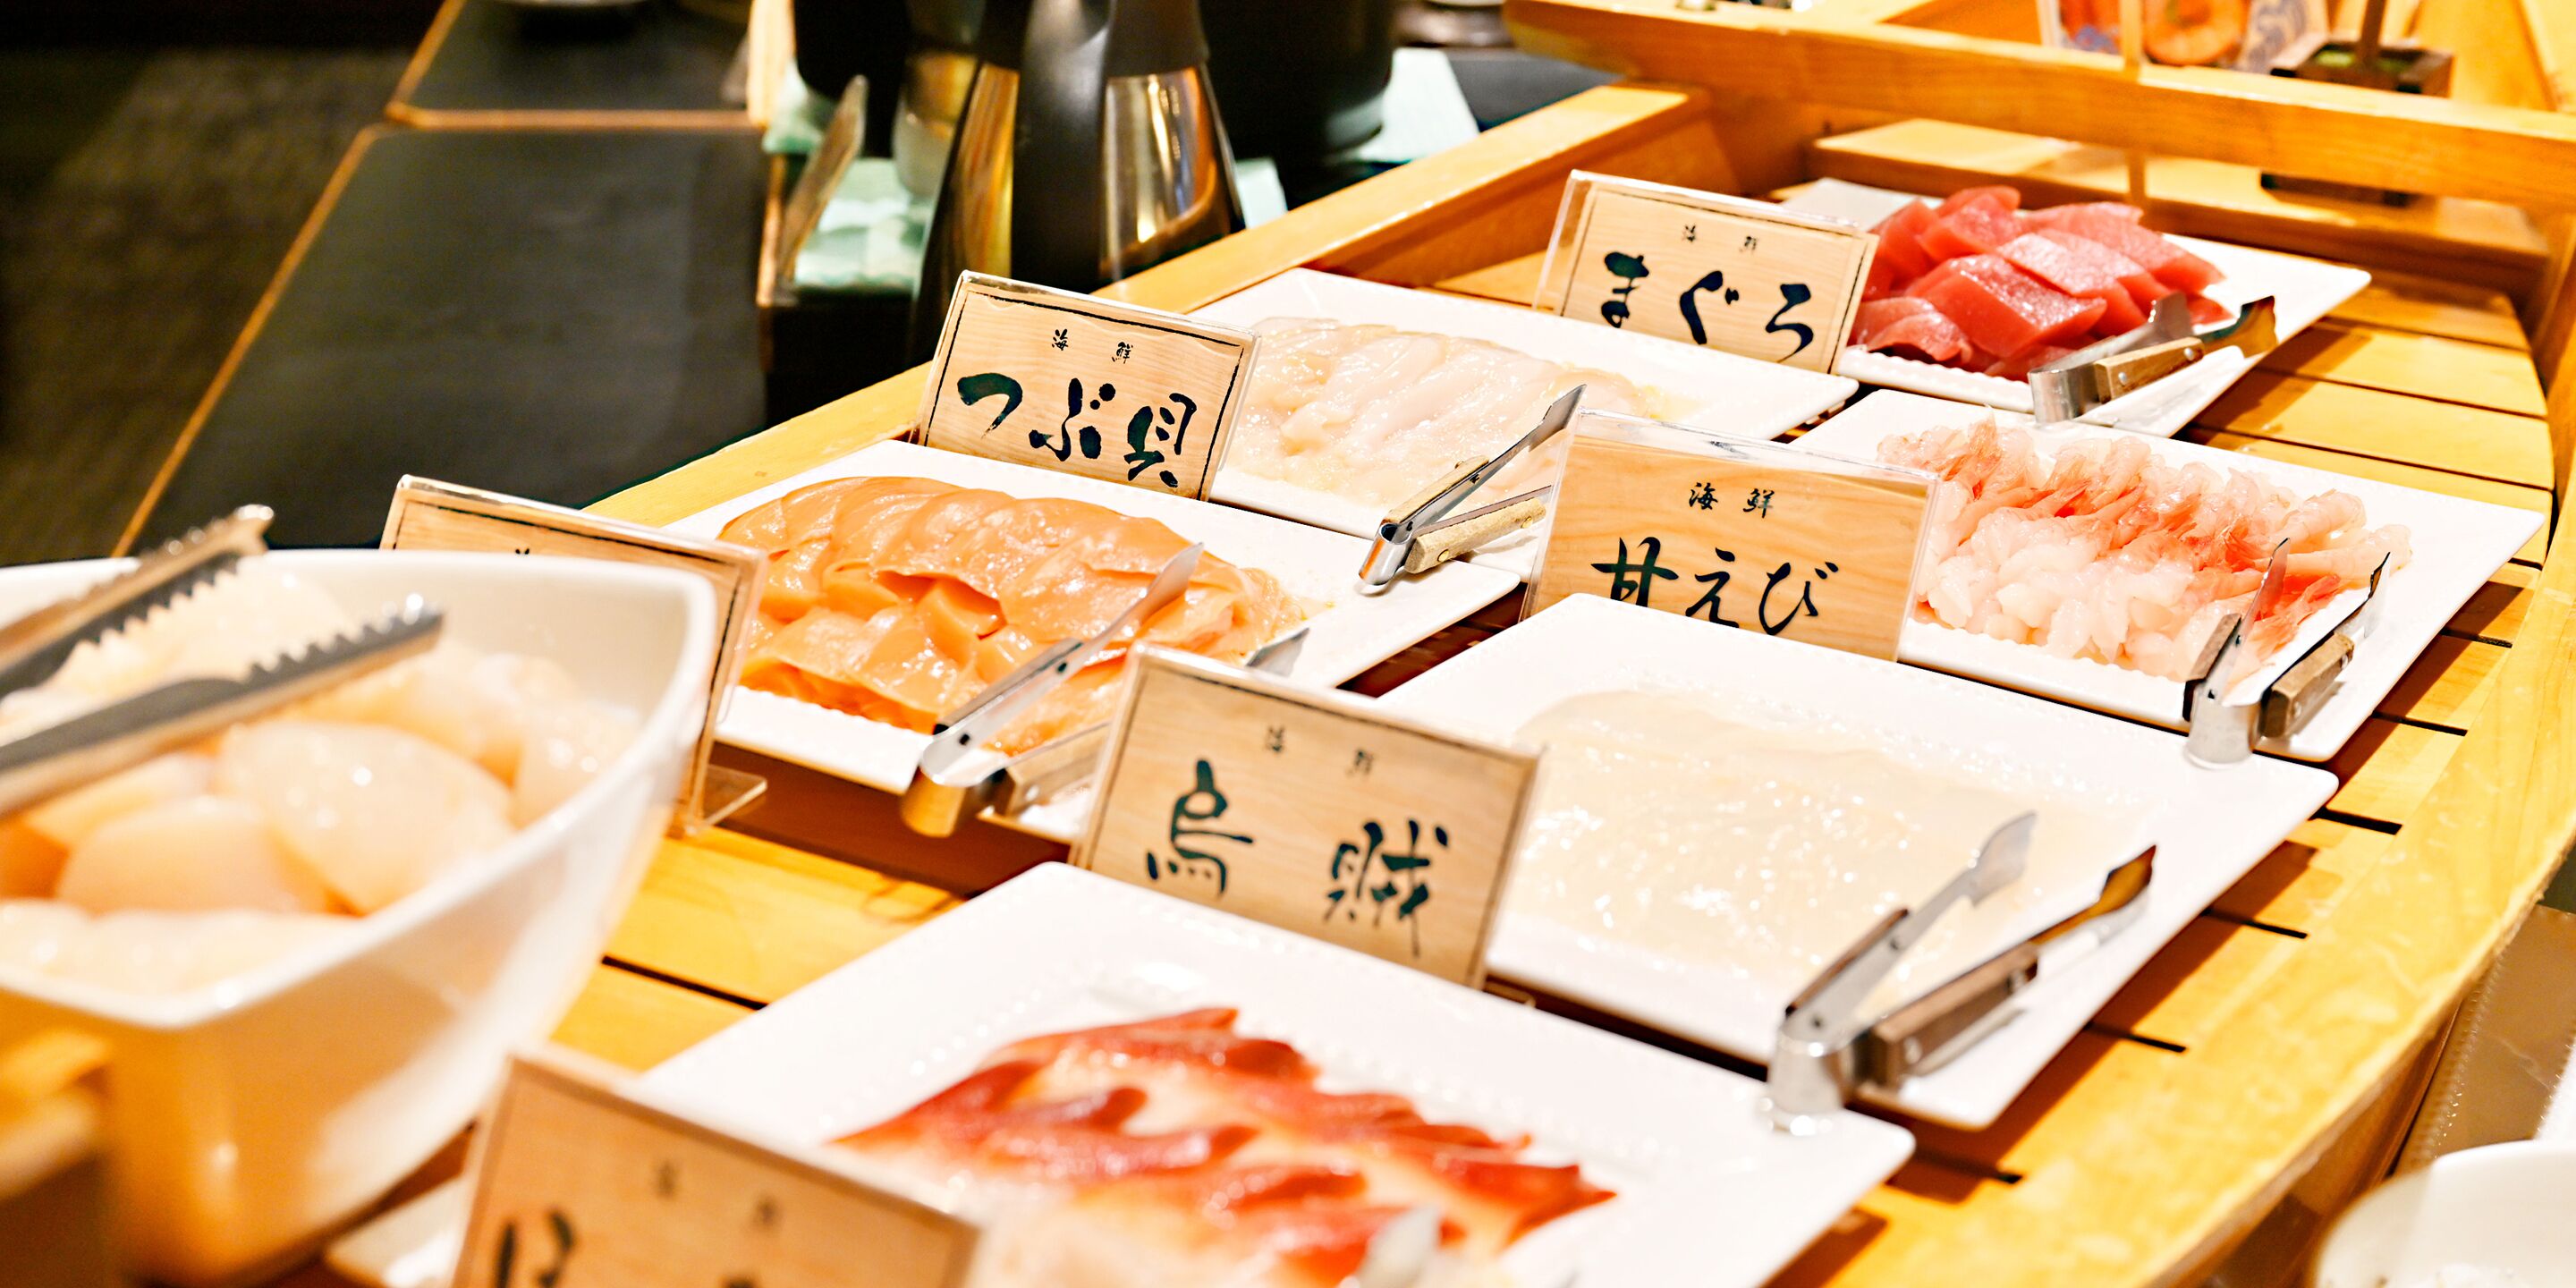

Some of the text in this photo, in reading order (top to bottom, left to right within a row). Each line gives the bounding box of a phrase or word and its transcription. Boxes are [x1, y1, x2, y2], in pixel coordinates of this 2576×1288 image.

[1051, 328, 1133, 365] 海鮮
[1601, 251, 1814, 363] まぐろ
[957, 372, 1197, 488] つぶ貝
[1689, 482, 1775, 518] 海鮮
[1590, 537, 1836, 635] 甘えび
